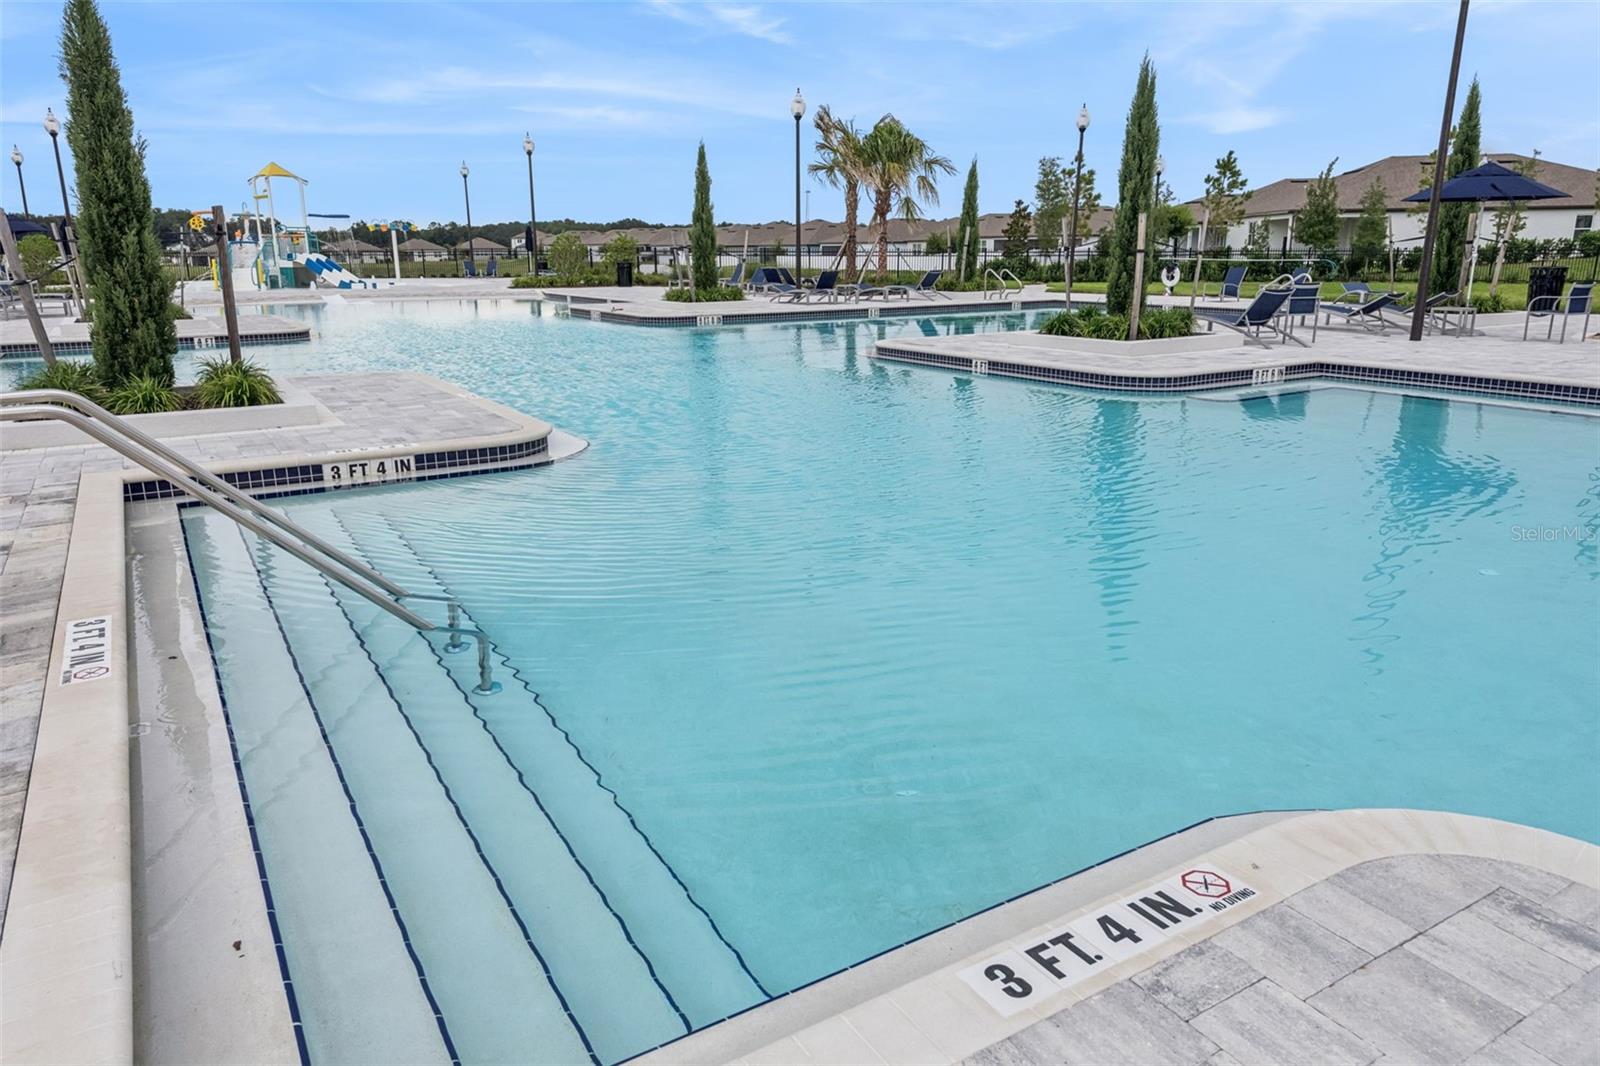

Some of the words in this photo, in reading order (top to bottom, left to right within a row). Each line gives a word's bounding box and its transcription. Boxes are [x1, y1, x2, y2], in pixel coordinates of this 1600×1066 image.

[1261, 369, 1269, 380] FT
[331, 466, 341, 480] 3
[348, 463, 368, 478] FT
[377, 461, 387, 475] 4
[395, 458, 411, 473] IN
[73, 619, 106, 628] 3
[71, 643, 105, 652] 4
[1208, 900, 1227, 912] NO
[1222, 887, 1256, 906] DIVING
[984, 963, 1033, 998] 3
[1024, 931, 1103, 980] FT.
[1096, 914, 1143, 944] 4
[1127, 890, 1203, 930] IN.
